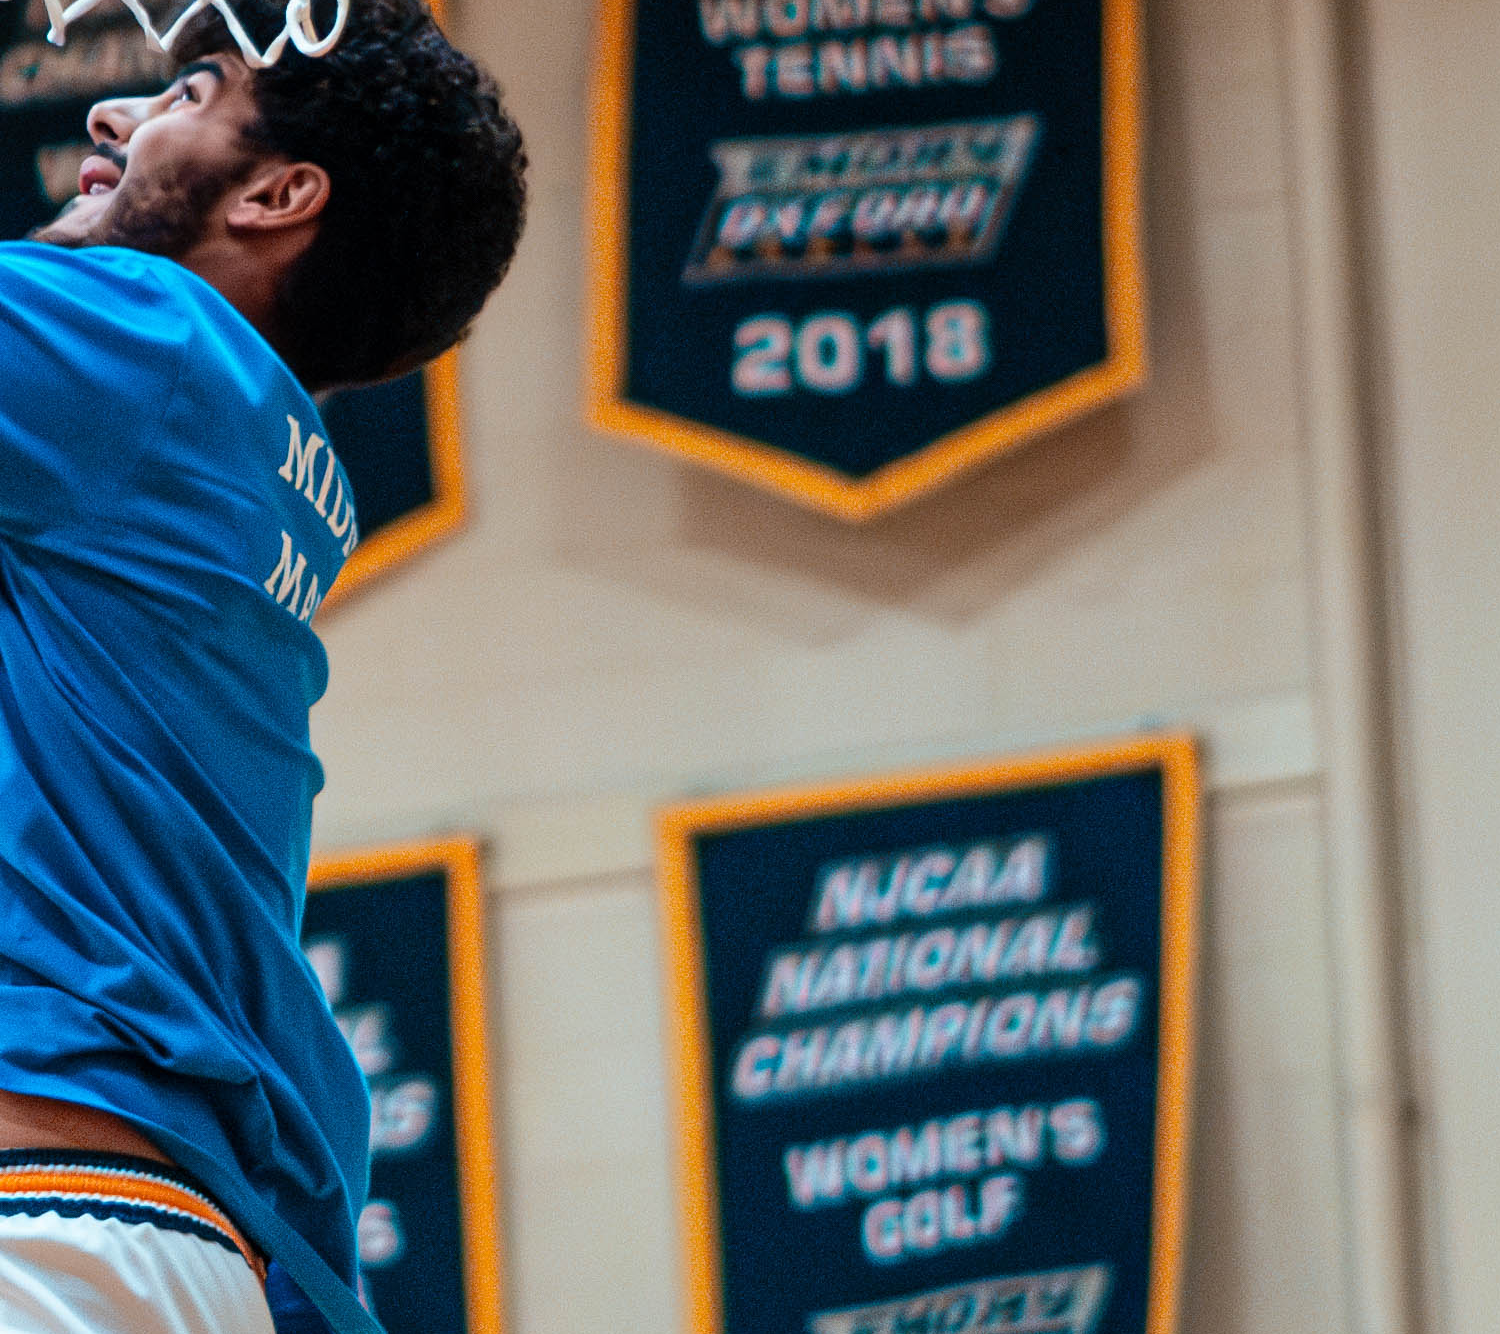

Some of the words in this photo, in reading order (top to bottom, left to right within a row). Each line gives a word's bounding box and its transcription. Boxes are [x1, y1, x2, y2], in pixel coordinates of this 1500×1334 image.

[740, 32, 990, 93] TENNIS
[737, 307, 984, 391] 2018
[820, 841, 1046, 925] NJCAA
[765, 909, 1093, 1013] NATIONAL
[739, 981, 1136, 1096] CHAMPIONS
[791, 1105, 1098, 1204] WOMEN'S
[869, 1183, 1016, 1257] GOLF
